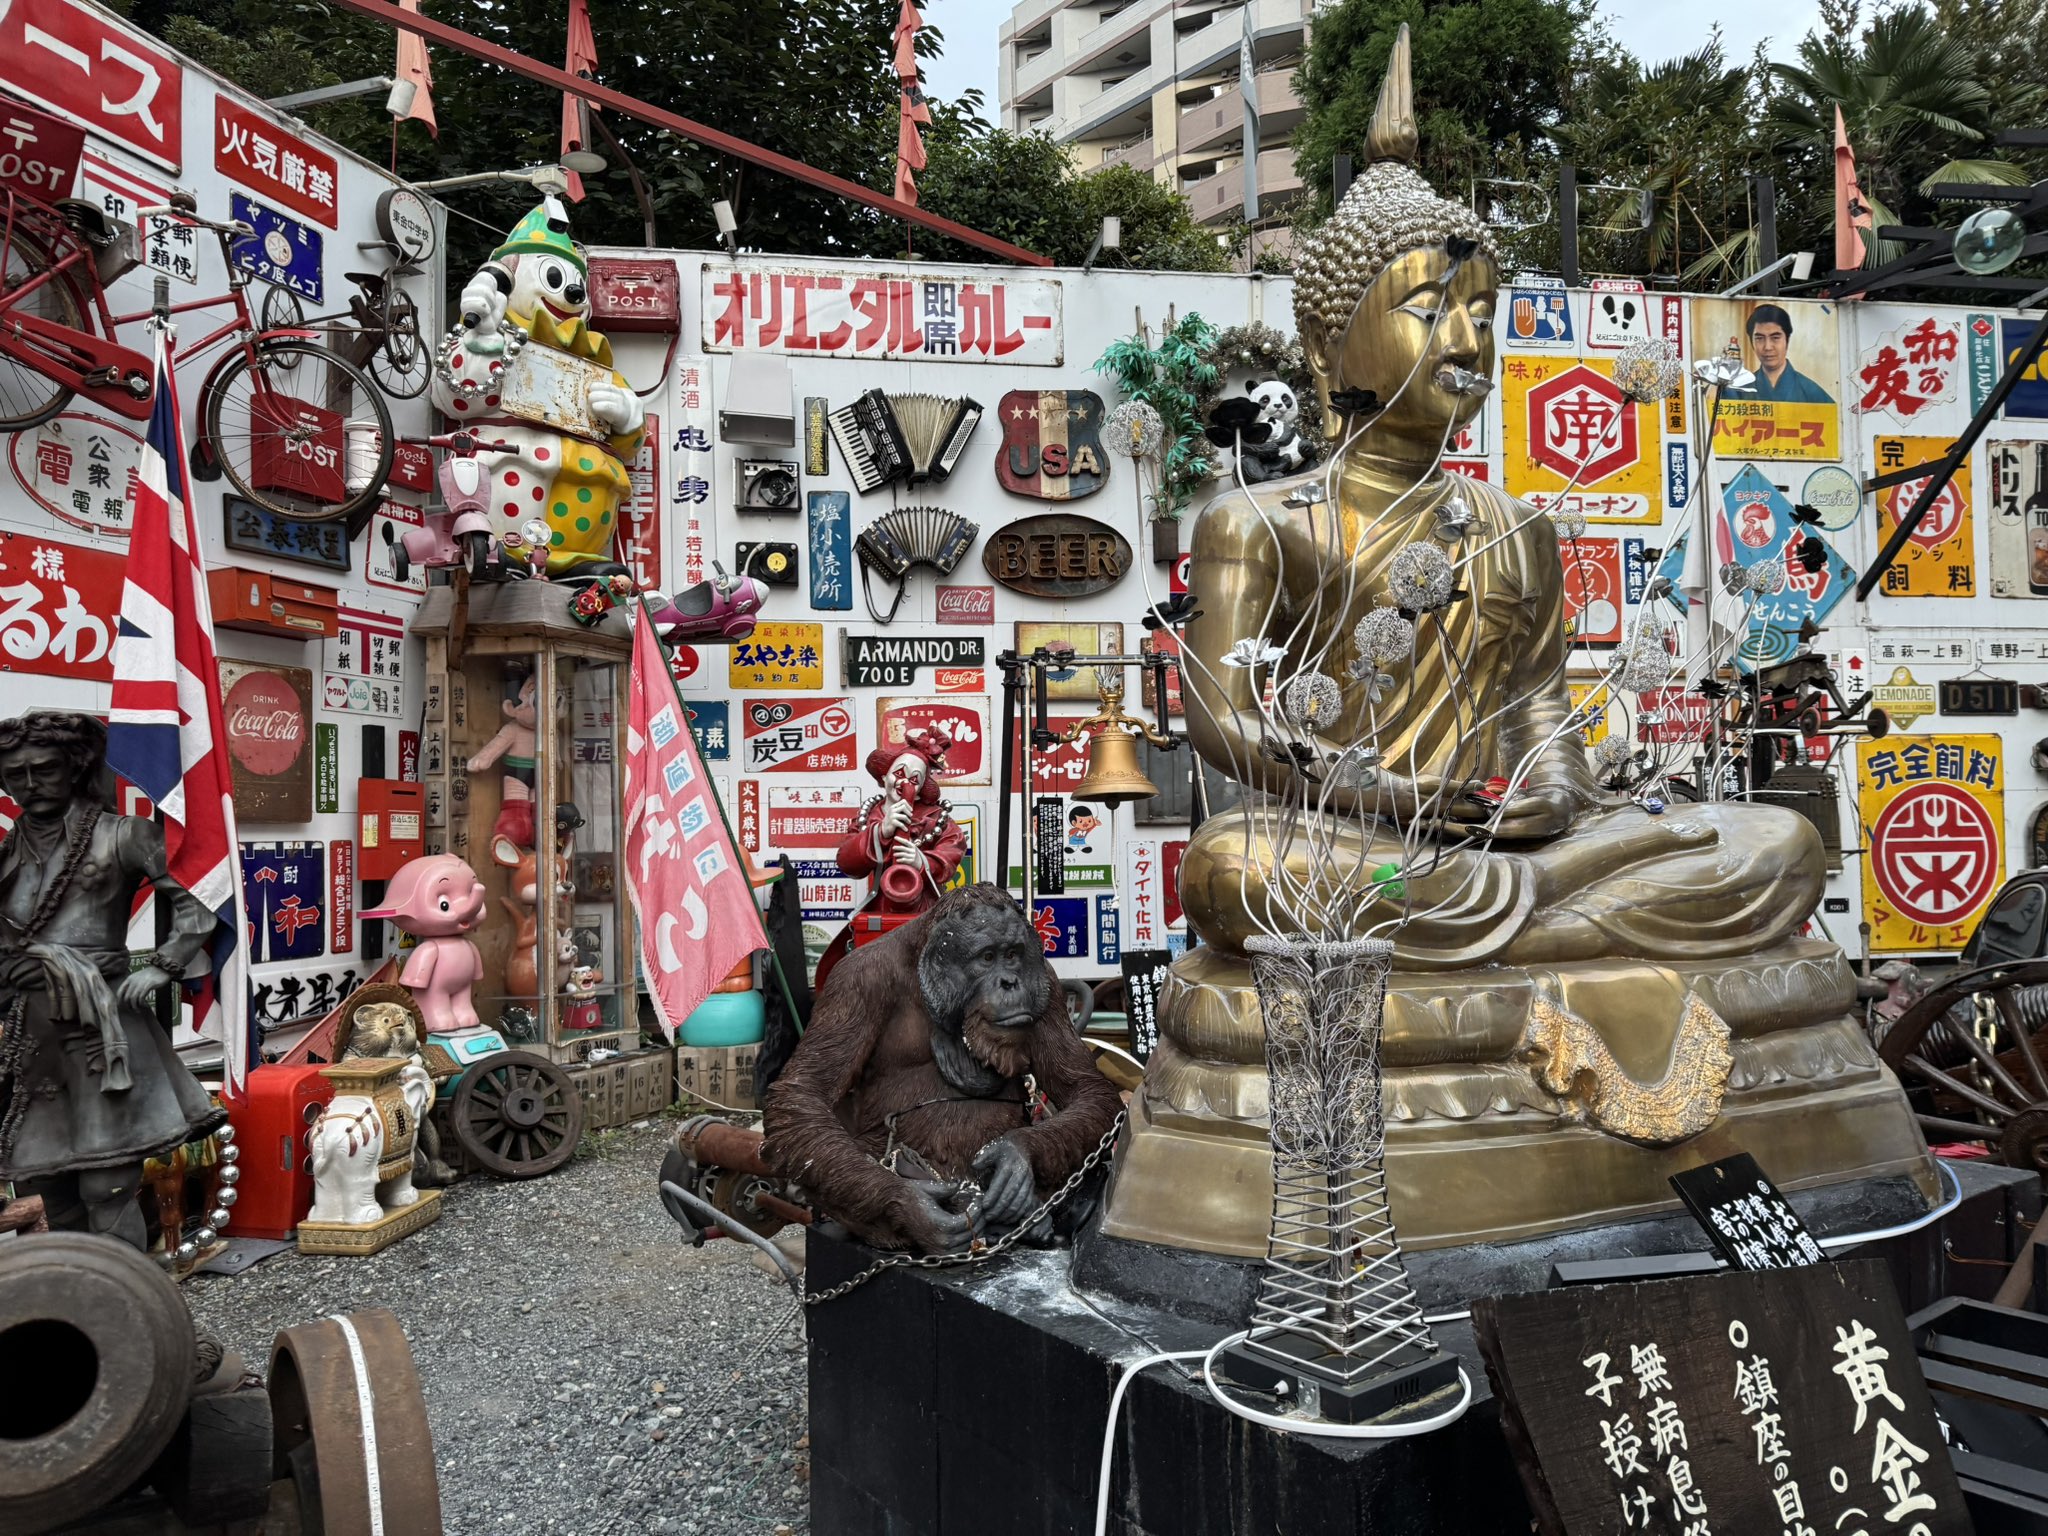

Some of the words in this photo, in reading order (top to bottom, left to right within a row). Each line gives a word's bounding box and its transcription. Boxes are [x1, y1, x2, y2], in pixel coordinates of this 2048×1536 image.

[0, 0, 164, 143] ース
[221, 116, 334, 209] 火気厳禁
[171, 222, 193, 279] 郵便
[608, 295, 658, 308] POST
[680, 368, 700, 409] 清酒
[1669, 380, 1682, 428] 険注意
[88, 435, 111, 489] 公衆
[285, 440, 338, 468] POST
[1009, 443, 1100, 479] USA
[2002, 448, 2022, 516] トリス
[73, 490, 123, 521] 電報
[818, 503, 842, 602] 塩小売所
[1000, 533, 1120, 579] BEER
[939, 590, 992, 612] Coca-Cola
[338, 630, 351, 669] 印紙
[373, 636, 384, 675] 切手類
[389, 640, 400, 677] 郵便
[858, 641, 954, 663] ARMANDO
[327, 687, 347, 696] ヤクルト
[753, 673, 799, 683] 特約店
[942, 671, 979, 684] Coca-Cola
[1874, 688, 1931, 700] LEMONADE
[253, 695, 279, 704] DRINK
[229, 706, 299, 740] Coca-Cola
[1867, 743, 1997, 791] 完全飼料
[743, 782, 757, 848] 火気厳禁
[802, 885, 852, 901] 山時計店
[1135, 861, 1152, 941] ダイヤ化成
[1101, 899, 1116, 960] 時間励行
[1129, 975, 1147, 1054] 使用されていた物
[1583, 1352, 1656, 1528] 子授け
